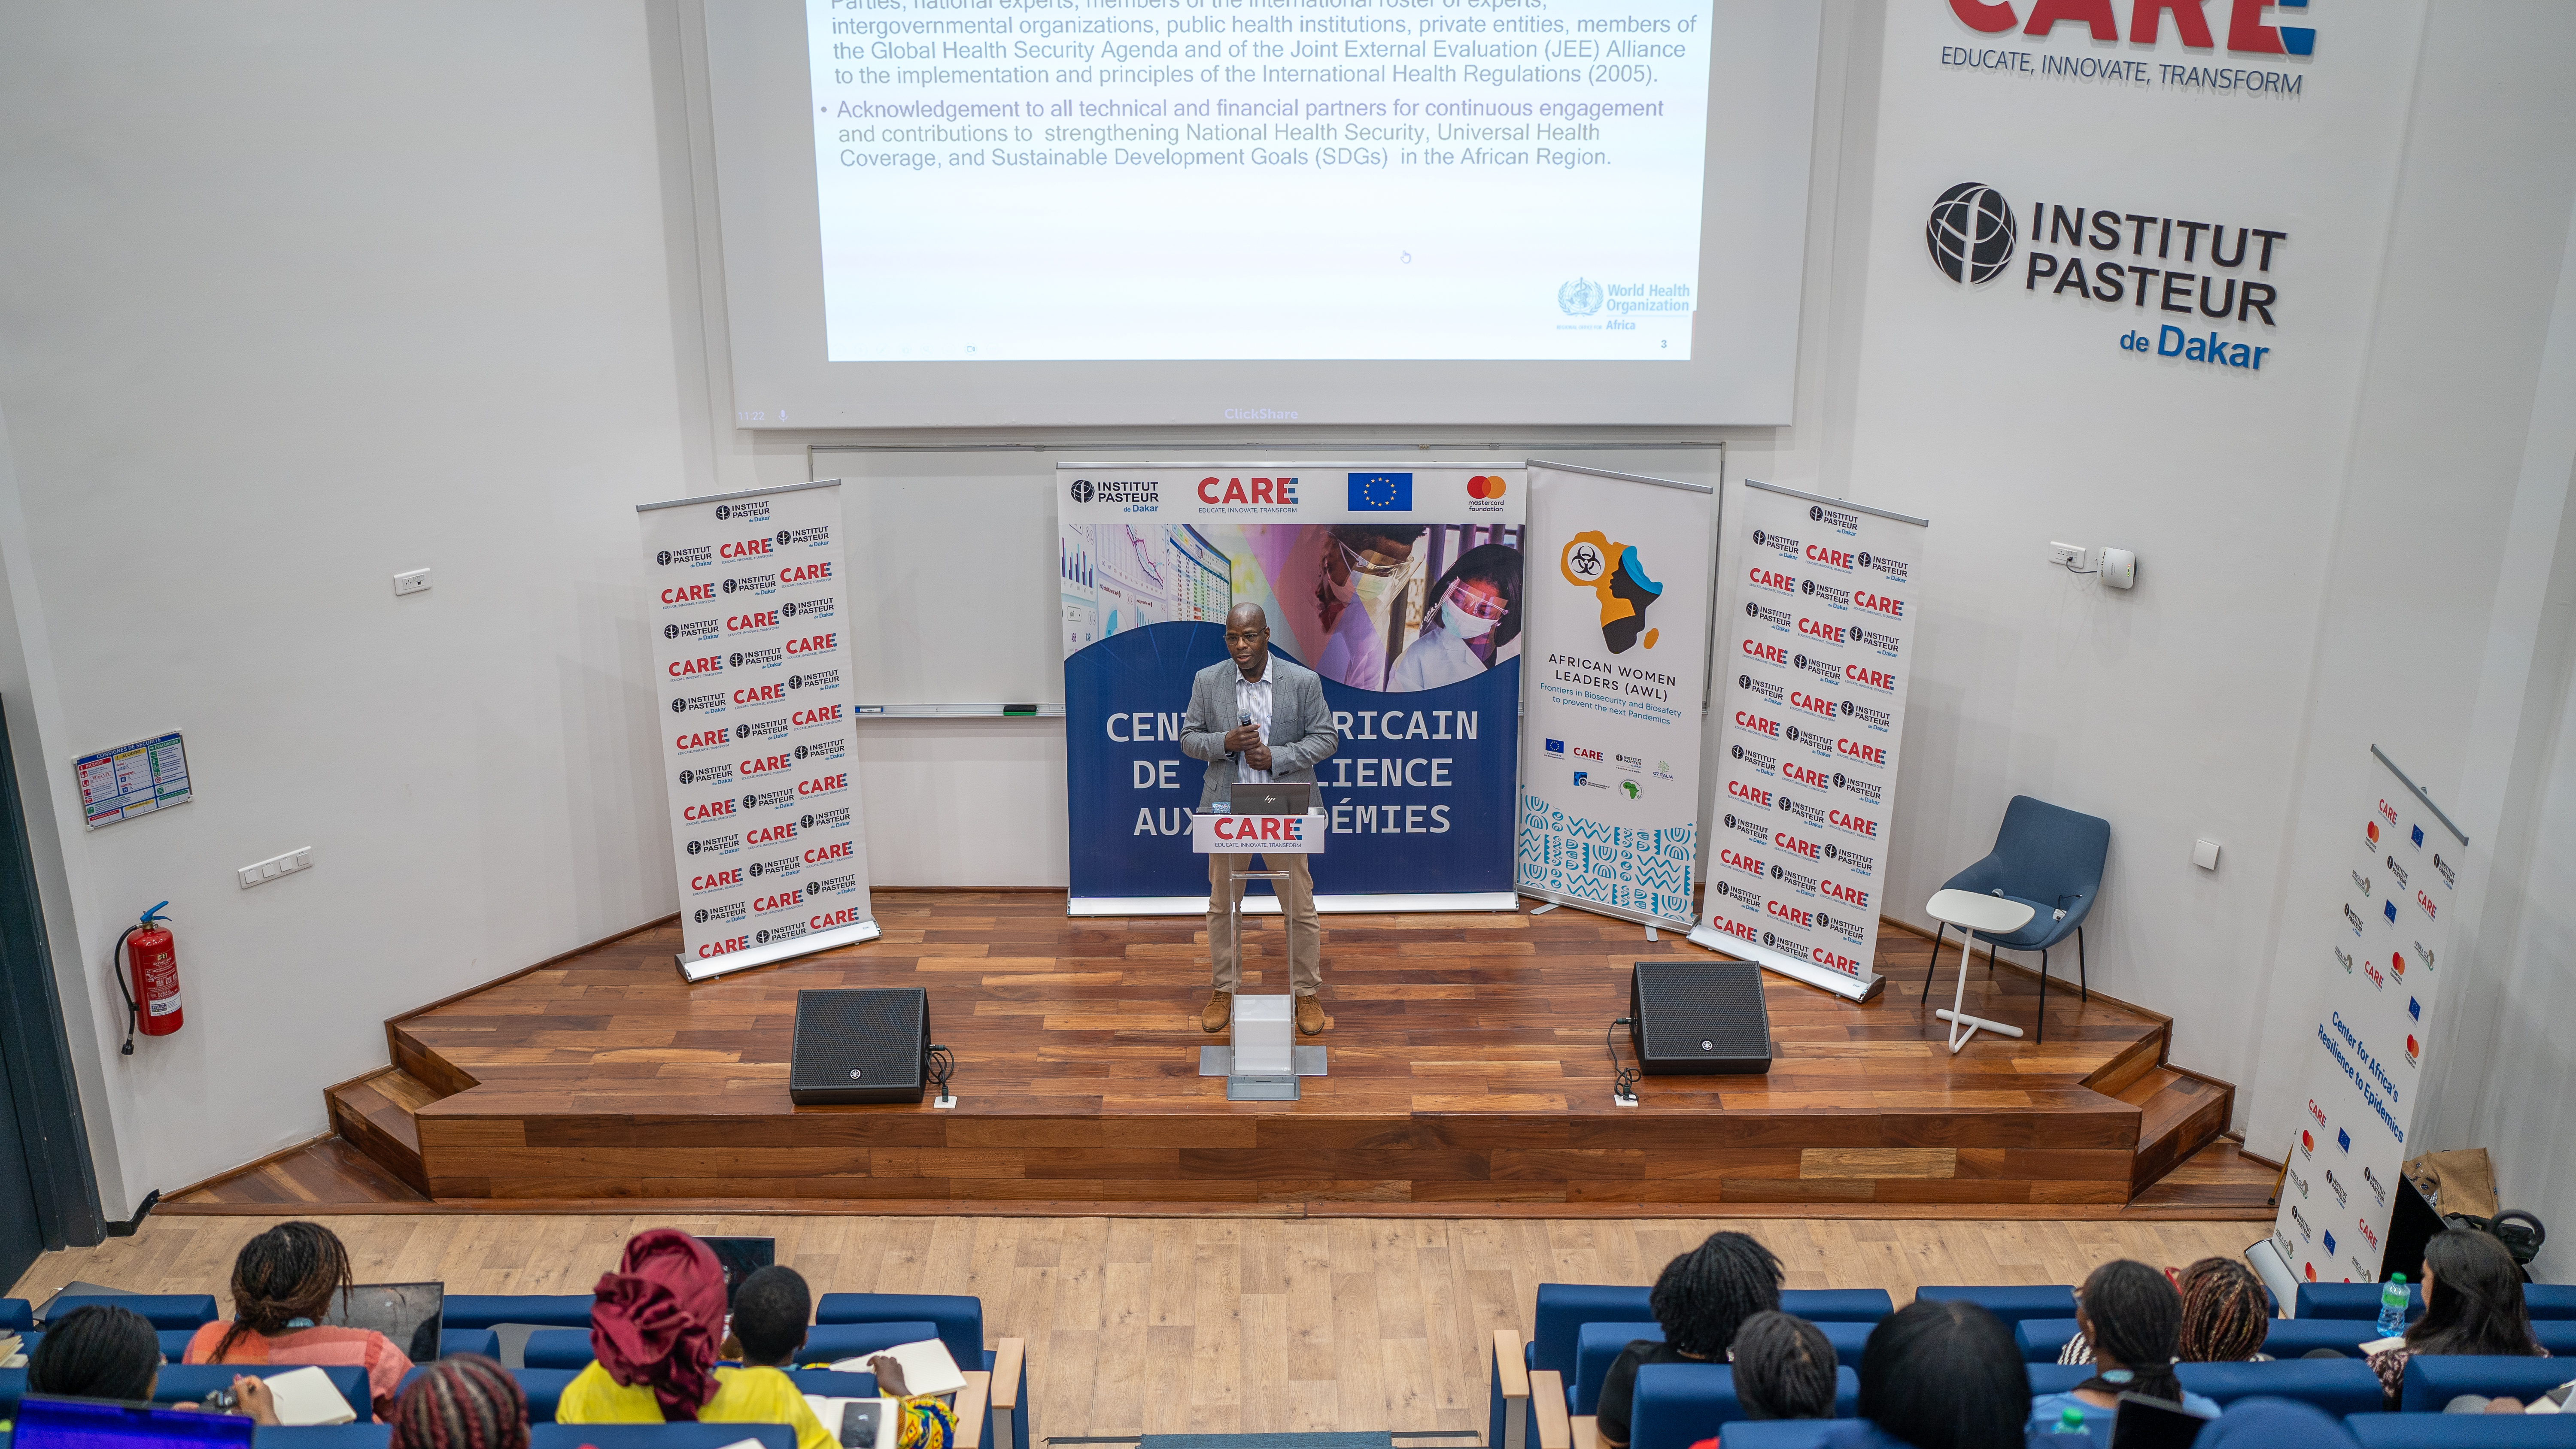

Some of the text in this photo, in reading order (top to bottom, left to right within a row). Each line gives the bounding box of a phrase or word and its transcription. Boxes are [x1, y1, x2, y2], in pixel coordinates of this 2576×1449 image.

[832, 14, 1698, 39] intergovernmental organizations, public health institutions, private entities, members of
[832, 39, 1686, 63] the Global Health Security Agenda and of the Joint External Evaluation (JEE) Alliance
[1941, 46, 2302, 95] EDUCATE, INNOVATE, TRANSFORM
[837, 98, 1664, 122] Acknowledgement to all technical and financial partners for continuous engagement
[838, 123, 1600, 146] and contributions to strengthening National Health Security, Universal Health
[840, 147, 1611, 171] Coverage, and Sustainable Development Goals (SDGs) in the African Region.
[2032, 202, 2287, 272] INSTITUT
[1608, 284, 1690, 297] World Health
[2026, 252, 2277, 326] PASTEUR
[1607, 299, 1689, 314] Organization
[1606, 319, 1636, 330] Africa
[1661, 340, 1667, 348] 3
[2120, 324, 2269, 370] de Dakar
[1224, 408, 1298, 419] ClickShare
[1098, 482, 1158, 491] INSTITUT
[1098, 493, 1159, 502] PASTEUR
[1197, 477, 1299, 504] CARE
[732, 501, 769, 512] INSTITUT
[732, 508, 770, 518] PASTEUR
[1825, 510, 1859, 523] INSTITUT
[1824, 517, 1857, 530] PASTEUR
[720, 538, 773, 558] CARE
[1806, 545, 1854, 570] CARE
[1549, 654, 1675, 686] AFRICAN WOMEN
[1556, 670, 1667, 702] LEADERS (AWL)
[1540, 682, 1574, 695] Frontiers
[1585, 691, 1626, 706] Biosecurity
[1629, 701, 1643, 709] and
[1646, 703, 1681, 718] Biosafety
[1563, 698, 1592, 709] prevent
[1595, 703, 1607, 712] the
[1628, 710, 1670, 725] Pandemics
[1106, 712, 1187, 742] CEN
[1332, 711, 1478, 740] RICAIN
[97, 746, 128, 759] CONSIGNES
[122, 749, 141, 758] ACCIDENT
[1574, 747, 1603, 761] CARE
[1133, 760, 1180, 789] DE
[1324, 798, 1450, 833] ÉMIES
[2379, 799, 2397, 825] CARE
[1214, 817, 1303, 840] CARE
[2392, 867, 2407, 886] PASTEUR
[2394, 861, 2408, 879] INSTITUT
[699, 935, 750, 958] CARE
[1813, 948, 1860, 976] CARE
[2332, 1011, 2399, 1103] Center for Africa's
[2318, 1023, 2403, 1143] Resilience to Epidemics
